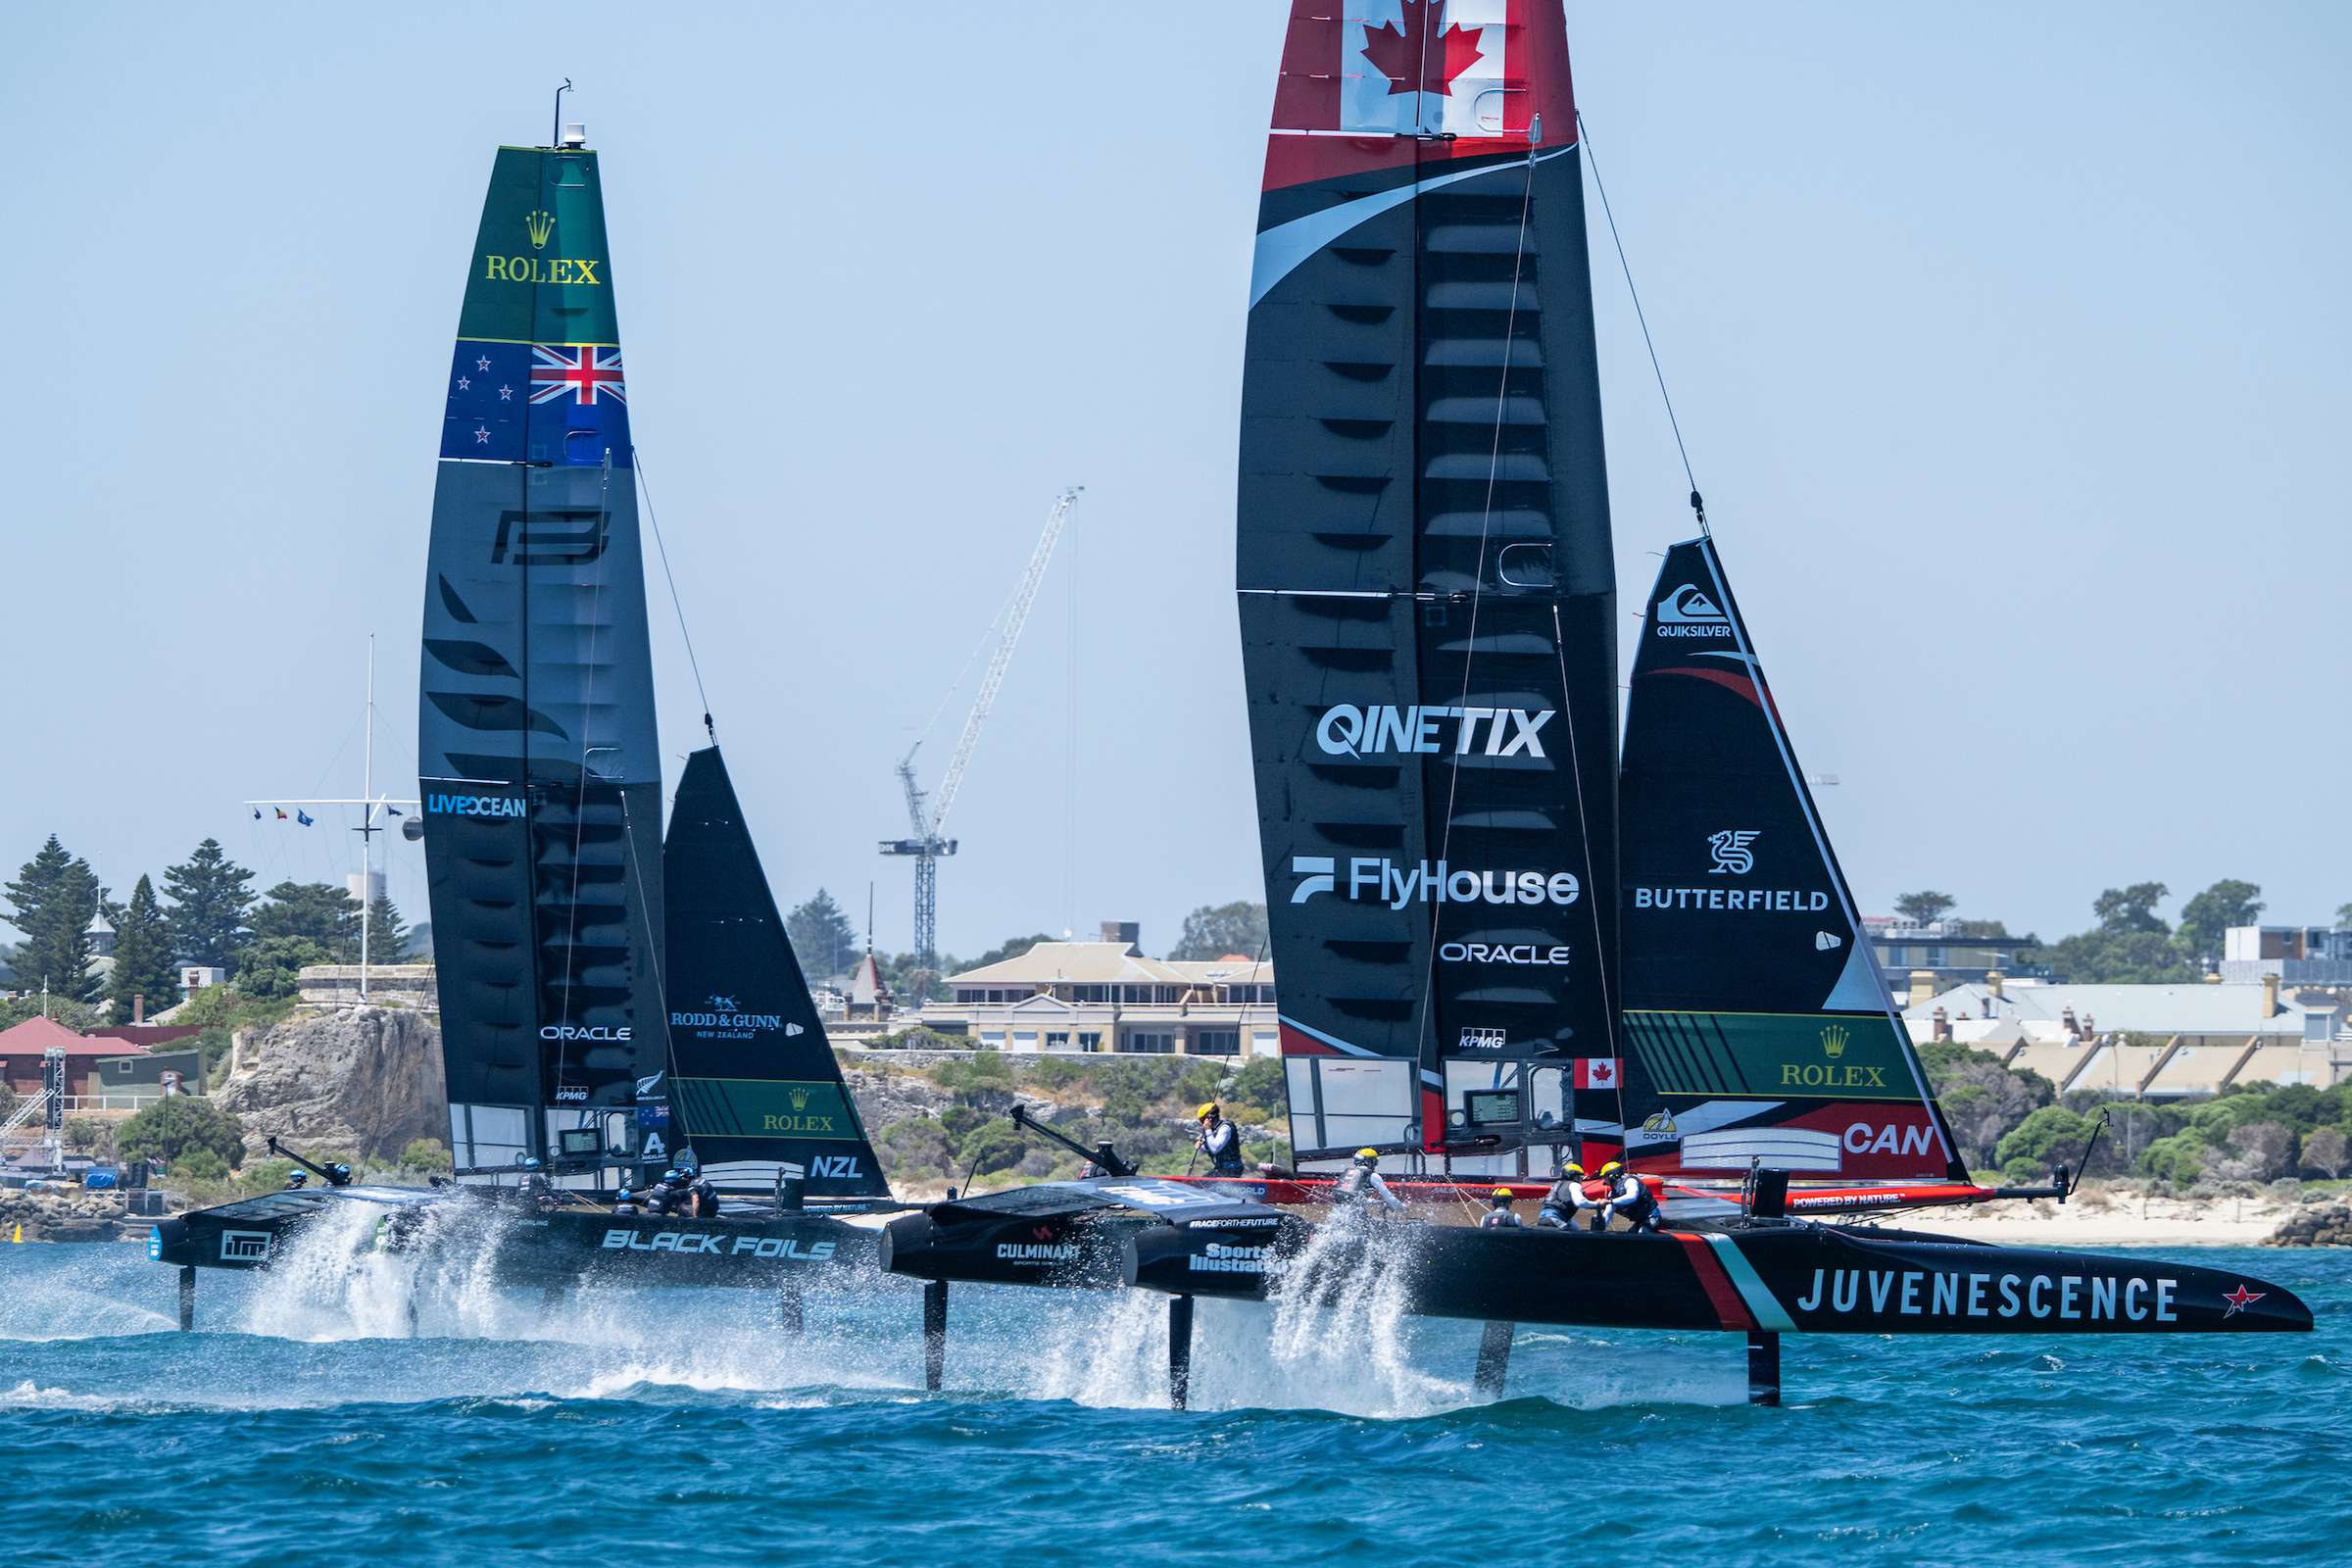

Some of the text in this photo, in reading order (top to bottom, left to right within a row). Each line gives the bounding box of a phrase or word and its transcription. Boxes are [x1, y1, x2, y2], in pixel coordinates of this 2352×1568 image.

[485, 255, 601, 284] ROLEX
[1656, 625, 1731, 637] QUIKSILVER
[1316, 704, 1557, 760] QINETIX
[1349, 857, 1580, 910] FlyHouse
[1635, 888, 1829, 911] BUTTERFIELD
[1439, 942, 1571, 965] ORACLE
[670, 1012, 781, 1028] RODD & GUNN
[540, 1026, 632, 1041] ORACLE
[1458, 1035, 1505, 1049] KPMG
[1781, 1064, 1886, 1088] ROLEX
[556, 1091, 588, 1101] KPMG
[763, 1114, 834, 1132] ROLEX
[1843, 1122, 1935, 1156] CAN
[810, 1155, 863, 1179] NZL
[1793, 1197, 1843, 1207] POWERED
[1844, 1195, 1858, 1205] BY
[1190, 1218, 1279, 1229] #RACEFORTHEFUTURE
[602, 1229, 837, 1260] BLACK FOILS
[998, 1244, 1081, 1258] CULMINANT
[1206, 1243, 1275, 1261] Sports
[1797, 1268, 2178, 1321] JUVENESCENCE
